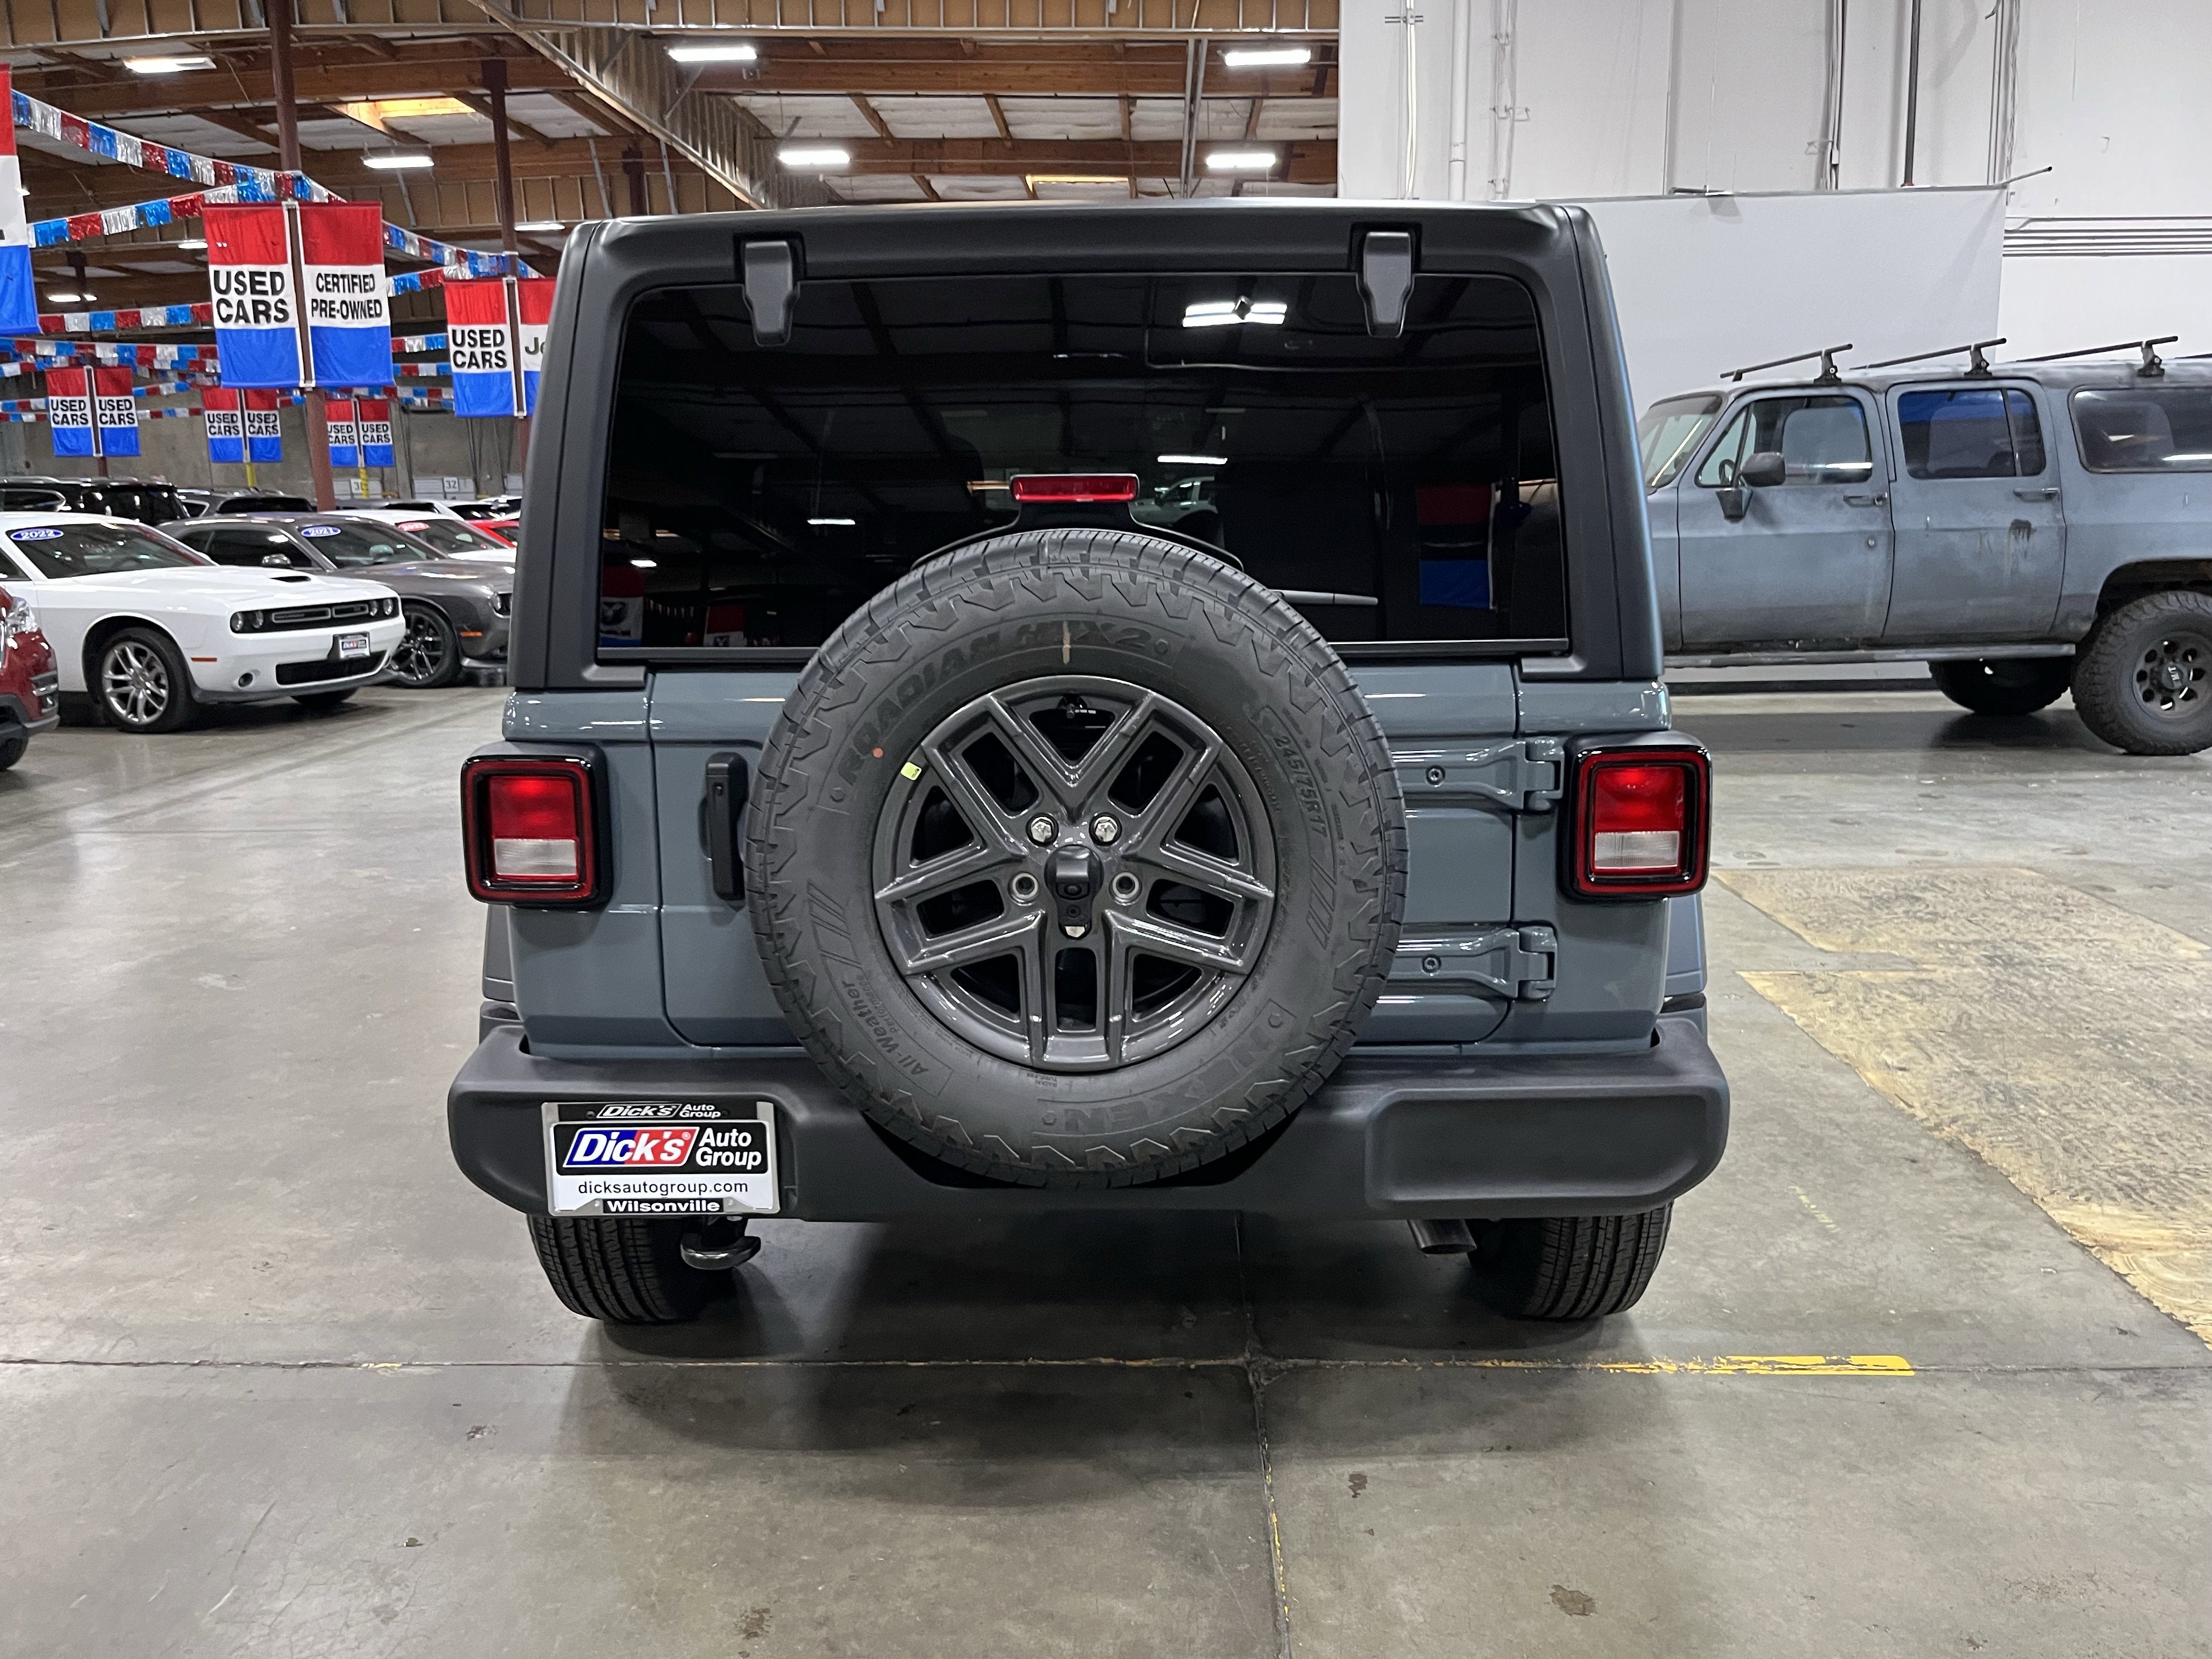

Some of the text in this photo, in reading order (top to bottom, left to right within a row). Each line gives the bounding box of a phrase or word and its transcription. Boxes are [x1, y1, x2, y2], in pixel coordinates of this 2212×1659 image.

[213, 270, 285, 296] USED
[315, 272, 376, 294] CERTIFIED
[216, 298, 290, 324] CARS
[311, 298, 382, 320] PRE-OWNED
[452, 329, 505, 348] USED
[453, 349, 507, 369] CARS
[50, 399, 87, 412] USED
[98, 399, 133, 411] USED
[52, 413, 89, 426] CARS
[99, 413, 136, 425] CARS
[207, 413, 238, 424] USED
[247, 413, 278, 424] USED
[208, 425, 240, 436] CARS
[248, 424, 279, 436] CARS
[362, 424, 389, 433] USED
[363, 434, 391, 443] CARS
[445, 480, 457, 489] 32
[21, 530, 55, 539] 2022
[841, 980, 929, 1075] All-Weather
[602, 1105, 673, 1116] Dick's
[679, 1110, 721, 1119] Group
[698, 1127, 752, 1147] Auto
[572, 1131, 685, 1162] Dick's
[696, 1147, 762, 1170] Group
[578, 1181, 748, 1196] dicksautogroup.com
[607, 1200, 720, 1213] Wilsonville
